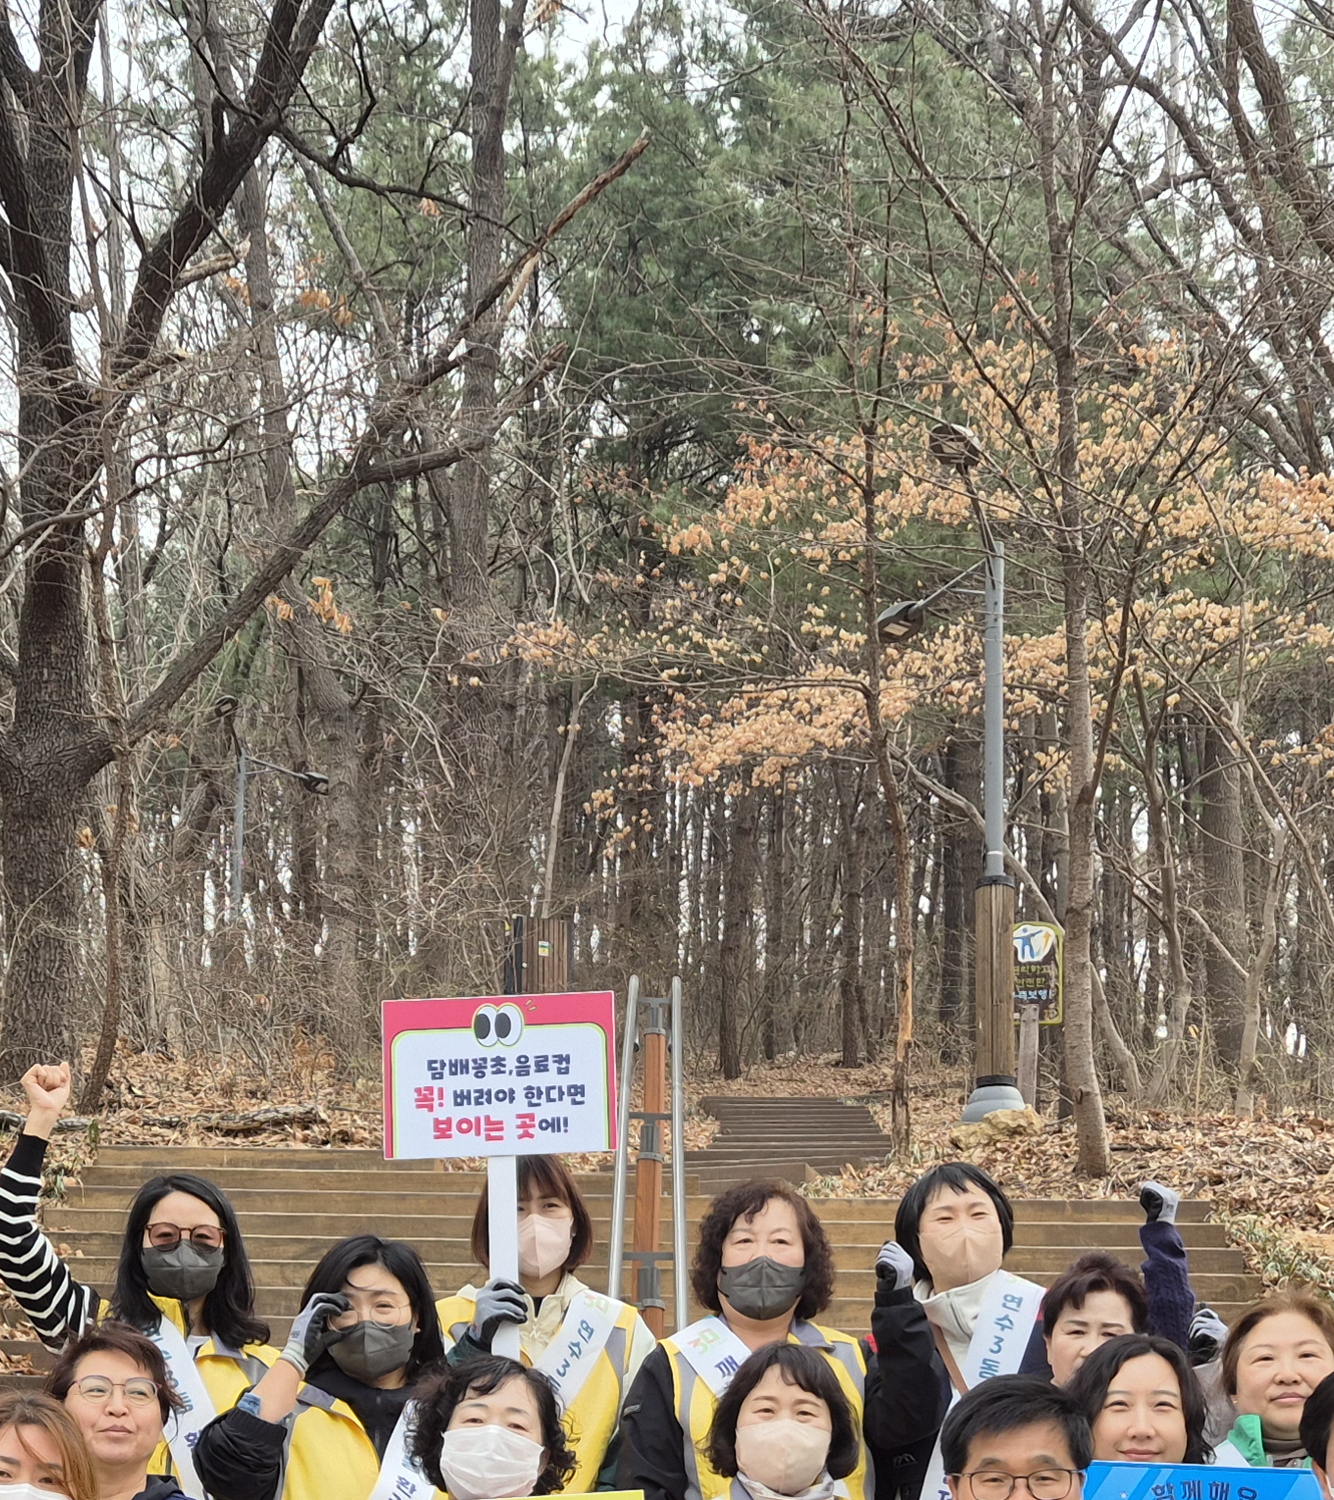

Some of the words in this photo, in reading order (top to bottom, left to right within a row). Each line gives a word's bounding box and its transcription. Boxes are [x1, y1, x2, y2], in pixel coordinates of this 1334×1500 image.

[426, 1053, 571, 1080] 담배꽁초,음료컵
[414, 1086, 445, 1112] 꼭!
[453, 1088, 516, 1107] 버려야
[523, 1084, 586, 1107] 한다면
[432, 1114, 505, 1141] 보이는
[515, 1112, 569, 1140] 곳에!
